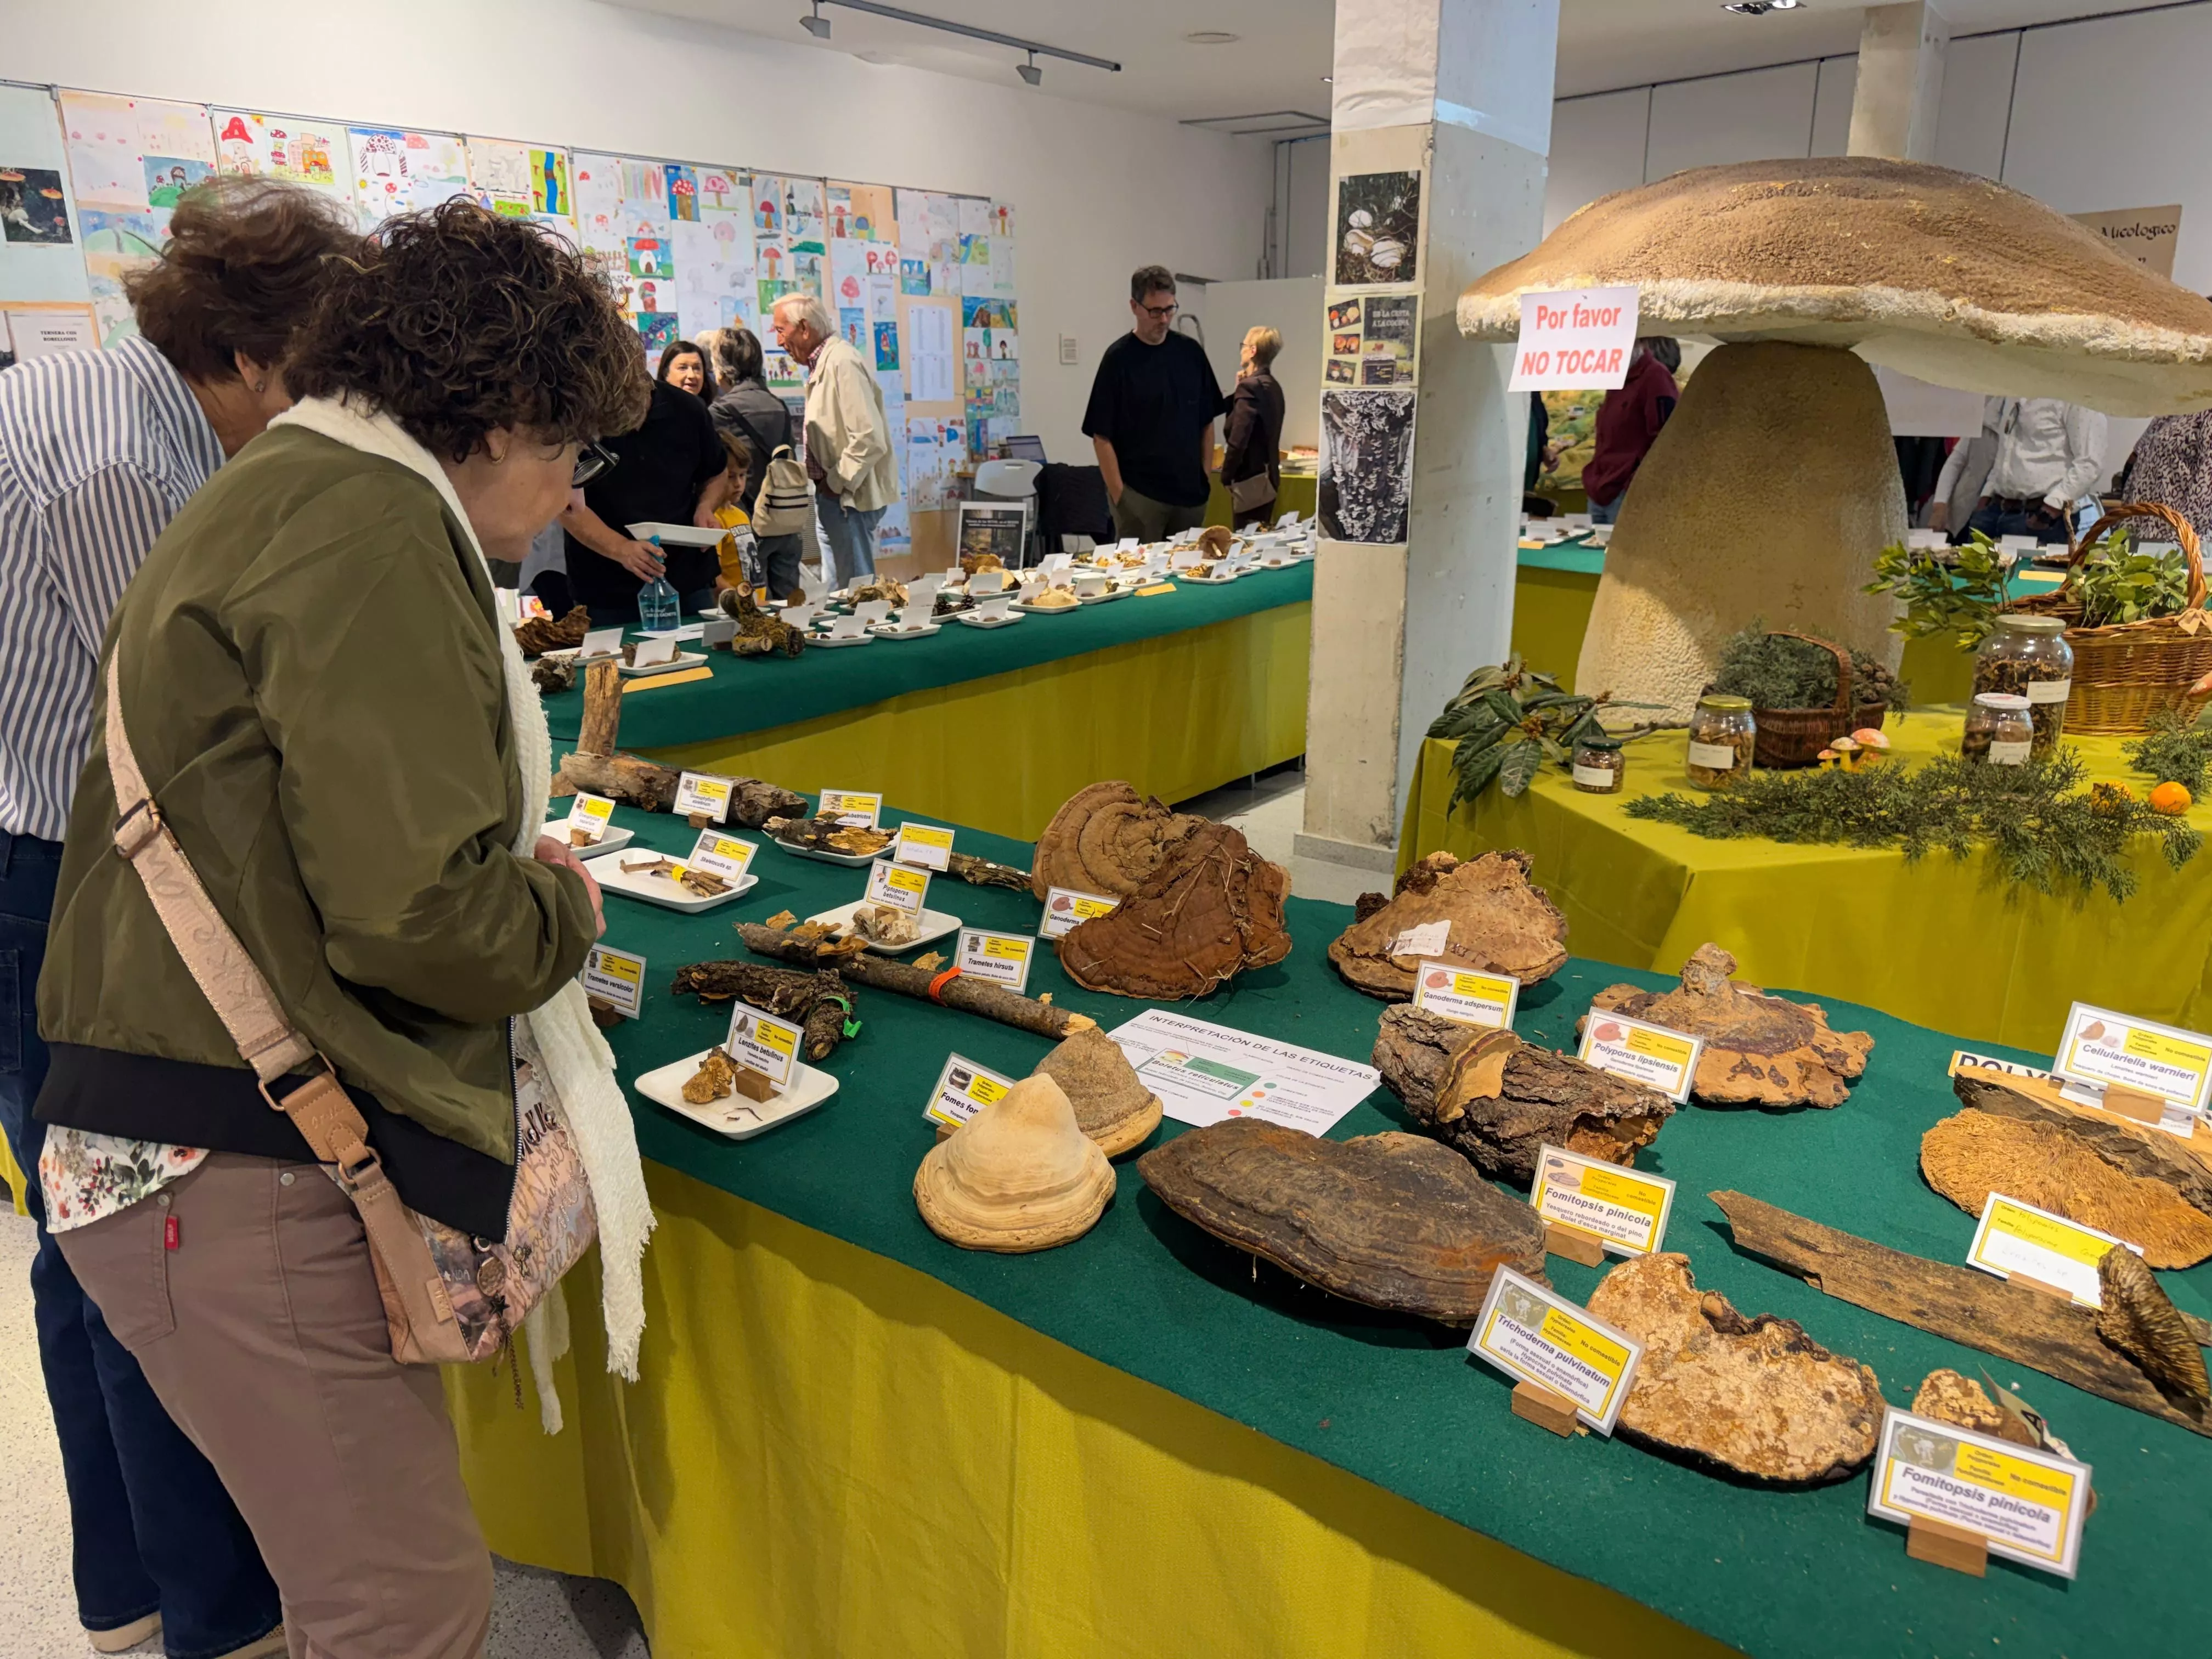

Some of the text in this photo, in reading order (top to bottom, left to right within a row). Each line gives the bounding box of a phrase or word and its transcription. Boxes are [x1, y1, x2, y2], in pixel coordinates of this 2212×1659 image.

[1537, 303, 1622, 330] Por favor
[1520, 348, 1623, 376] NO TOCAR
[882, 884, 909, 896] Piptoporus
[883, 891, 905, 902] betulinus
[1049, 913, 1080, 925] Ganoderma
[968, 957, 1014, 971] Trametes hirsuta
[587, 972, 608, 986] Trametes
[1423, 991, 1503, 1013] Ganoderma adspersum
[738, 1036, 783, 1064] Lenzites betulinus
[1148, 1014, 1252, 1046] INTERPRETACIÓN
[1251, 1043, 1272, 1052] DE
[1272, 1048, 1298, 1059] LAS
[1299, 1056, 1374, 1080] ETIQUETAS
[1594, 1042, 1679, 1074] Polyporus lipsiensis
[2174, 1049, 2207, 1062] comestible
[1151, 1060, 1188, 1073] Boletus
[1187, 1071, 1240, 1090] reticulatus
[2082, 1043, 2196, 1081] Cellulariella warnieri
[940, 1091, 966, 1108] Fomes
[1544, 1186, 1652, 1229] Fomitopsis pinicola
[1626, 1192, 1656, 1206] comestible
[1545, 1201, 1574, 1217] Yesquero
[1575, 1211, 1610, 1228] rebordeado
[1616, 1224, 1627, 1233] del
[1627, 1228, 1644, 1240] pino,
[1560, 1212, 1626, 1240] Bolet d'esca marginat
[1557, 1314, 1572, 1327] Orden:
[1497, 1313, 1611, 1390] Trichoderma pulvinatum
[1509, 1337, 1530, 1354] (Forma
[1529, 1349, 1551, 1366] asexual
[1555, 1364, 1589, 1390] anamórfica)
[1580, 1339, 1621, 1367] No comestible
[1519, 1356, 1537, 1372] forma
[1536, 1367, 1554, 1382] sexual
[1558, 1380, 1590, 1404] telemórfica
[1520, 1351, 1573, 1387] Hypocrea pulvinata
[1901, 1465, 2052, 1526] Fomitopsis pinicola
